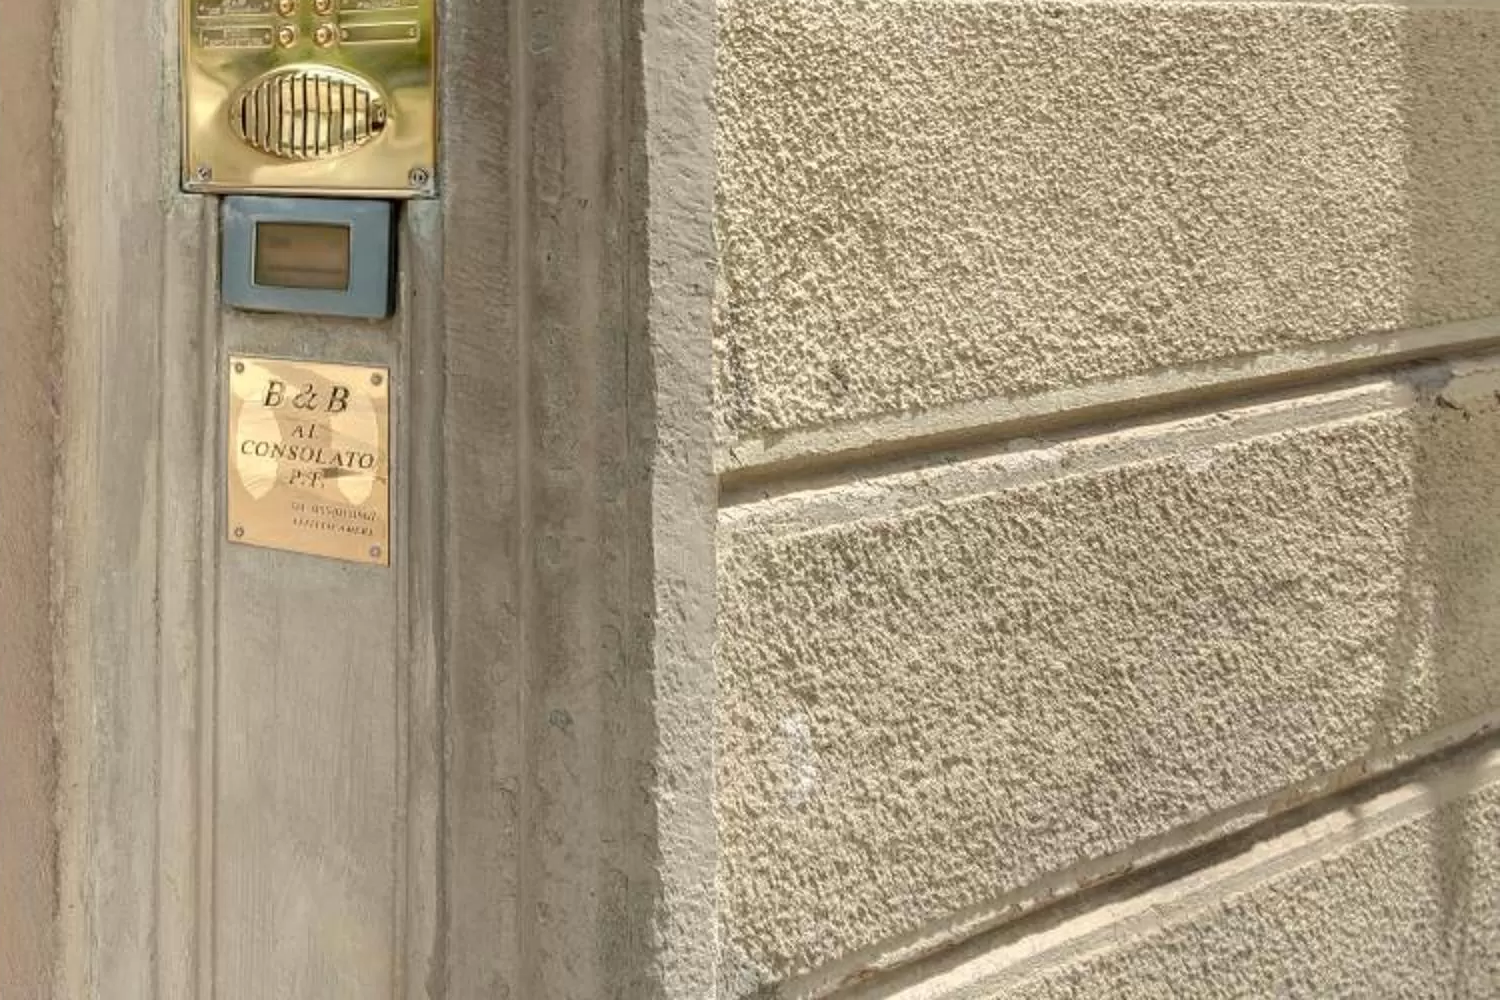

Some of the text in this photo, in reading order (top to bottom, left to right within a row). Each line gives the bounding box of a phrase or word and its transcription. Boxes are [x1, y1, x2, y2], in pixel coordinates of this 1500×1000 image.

[263, 379, 351, 413] B & B
[240, 439, 375, 469] CONSOLATO
